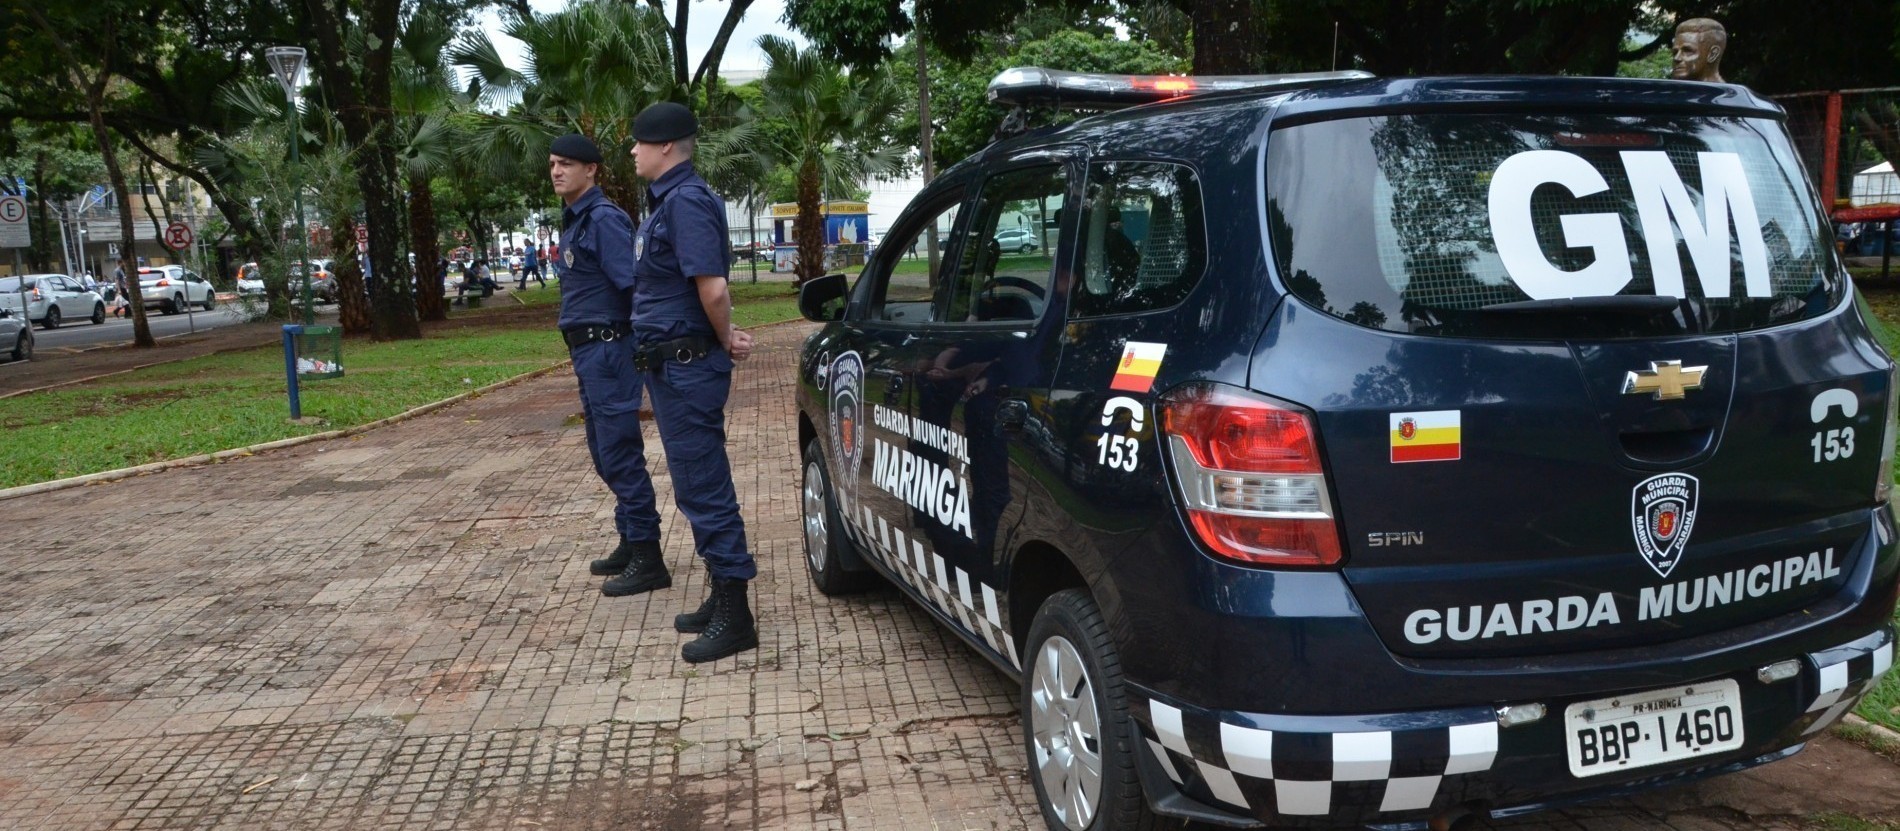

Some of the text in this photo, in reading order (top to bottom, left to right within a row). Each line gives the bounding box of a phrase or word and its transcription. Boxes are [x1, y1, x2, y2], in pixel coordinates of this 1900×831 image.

[7, 203, 16, 217] E
[1488, 149, 1772, 300] GM
[874, 404, 971, 465] GUARDA MUNICIPAL
[1097, 432, 1139, 472] 153
[1811, 426, 1855, 463] 153
[872, 438, 973, 539] MARINGÁ
[1642, 486, 1689, 504] MUNICIPAL
[1647, 477, 1687, 491] GUARDA
[1368, 531, 1424, 547] SPIN
[1636, 515, 1655, 559] MARINGÁ
[1674, 510, 1694, 550] PARANÁ
[1658, 560, 1672, 568] 2007
[1403, 548, 1840, 644] GUARDA MUNICIPAL
